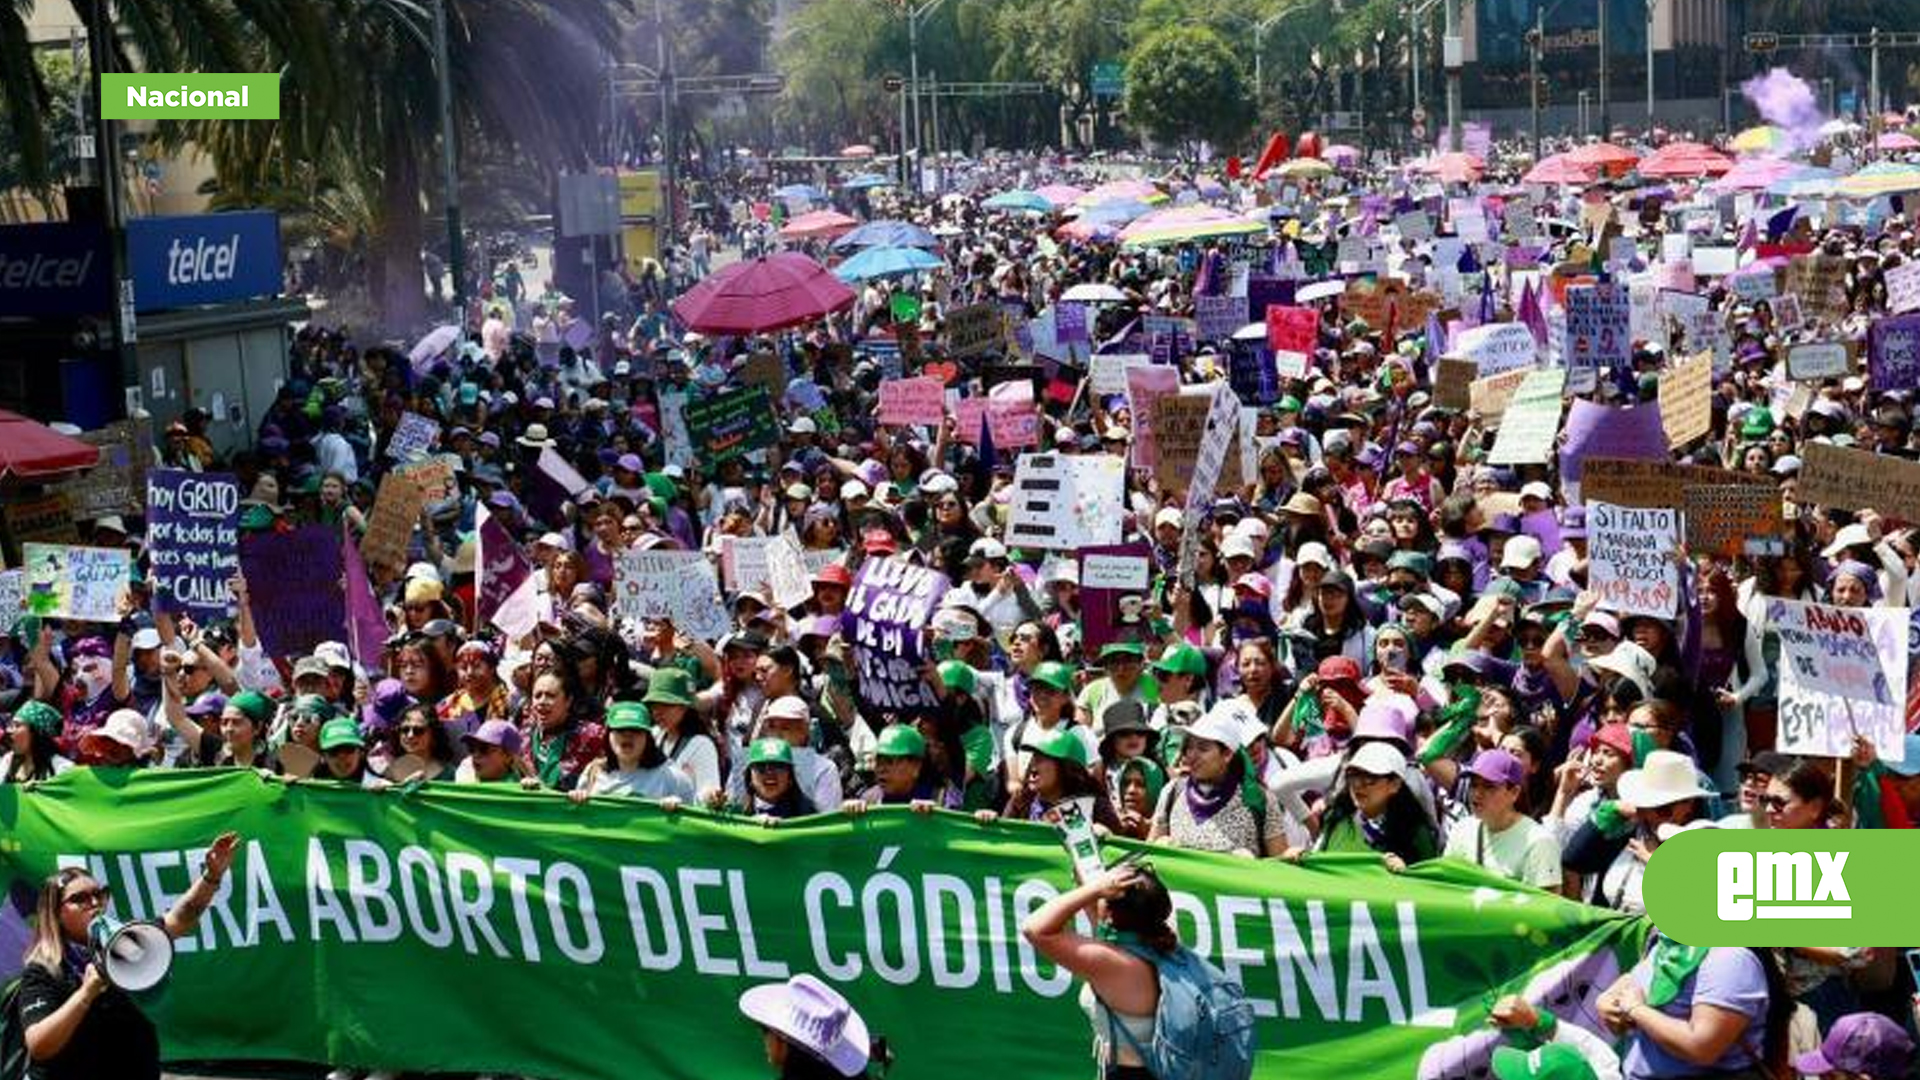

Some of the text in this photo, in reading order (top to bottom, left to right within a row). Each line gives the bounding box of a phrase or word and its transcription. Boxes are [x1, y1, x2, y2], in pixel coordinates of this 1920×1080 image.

[168, 234, 240, 284] telcel
[148, 478, 175, 512] hoy
[179, 479, 238, 515] GRITO
[1621, 509, 1669, 531] FALTO
[184, 550, 210, 571] que
[1795, 656, 1819, 678] DE
[305, 837, 606, 965] ABORTO
[619, 865, 790, 978] DEL
